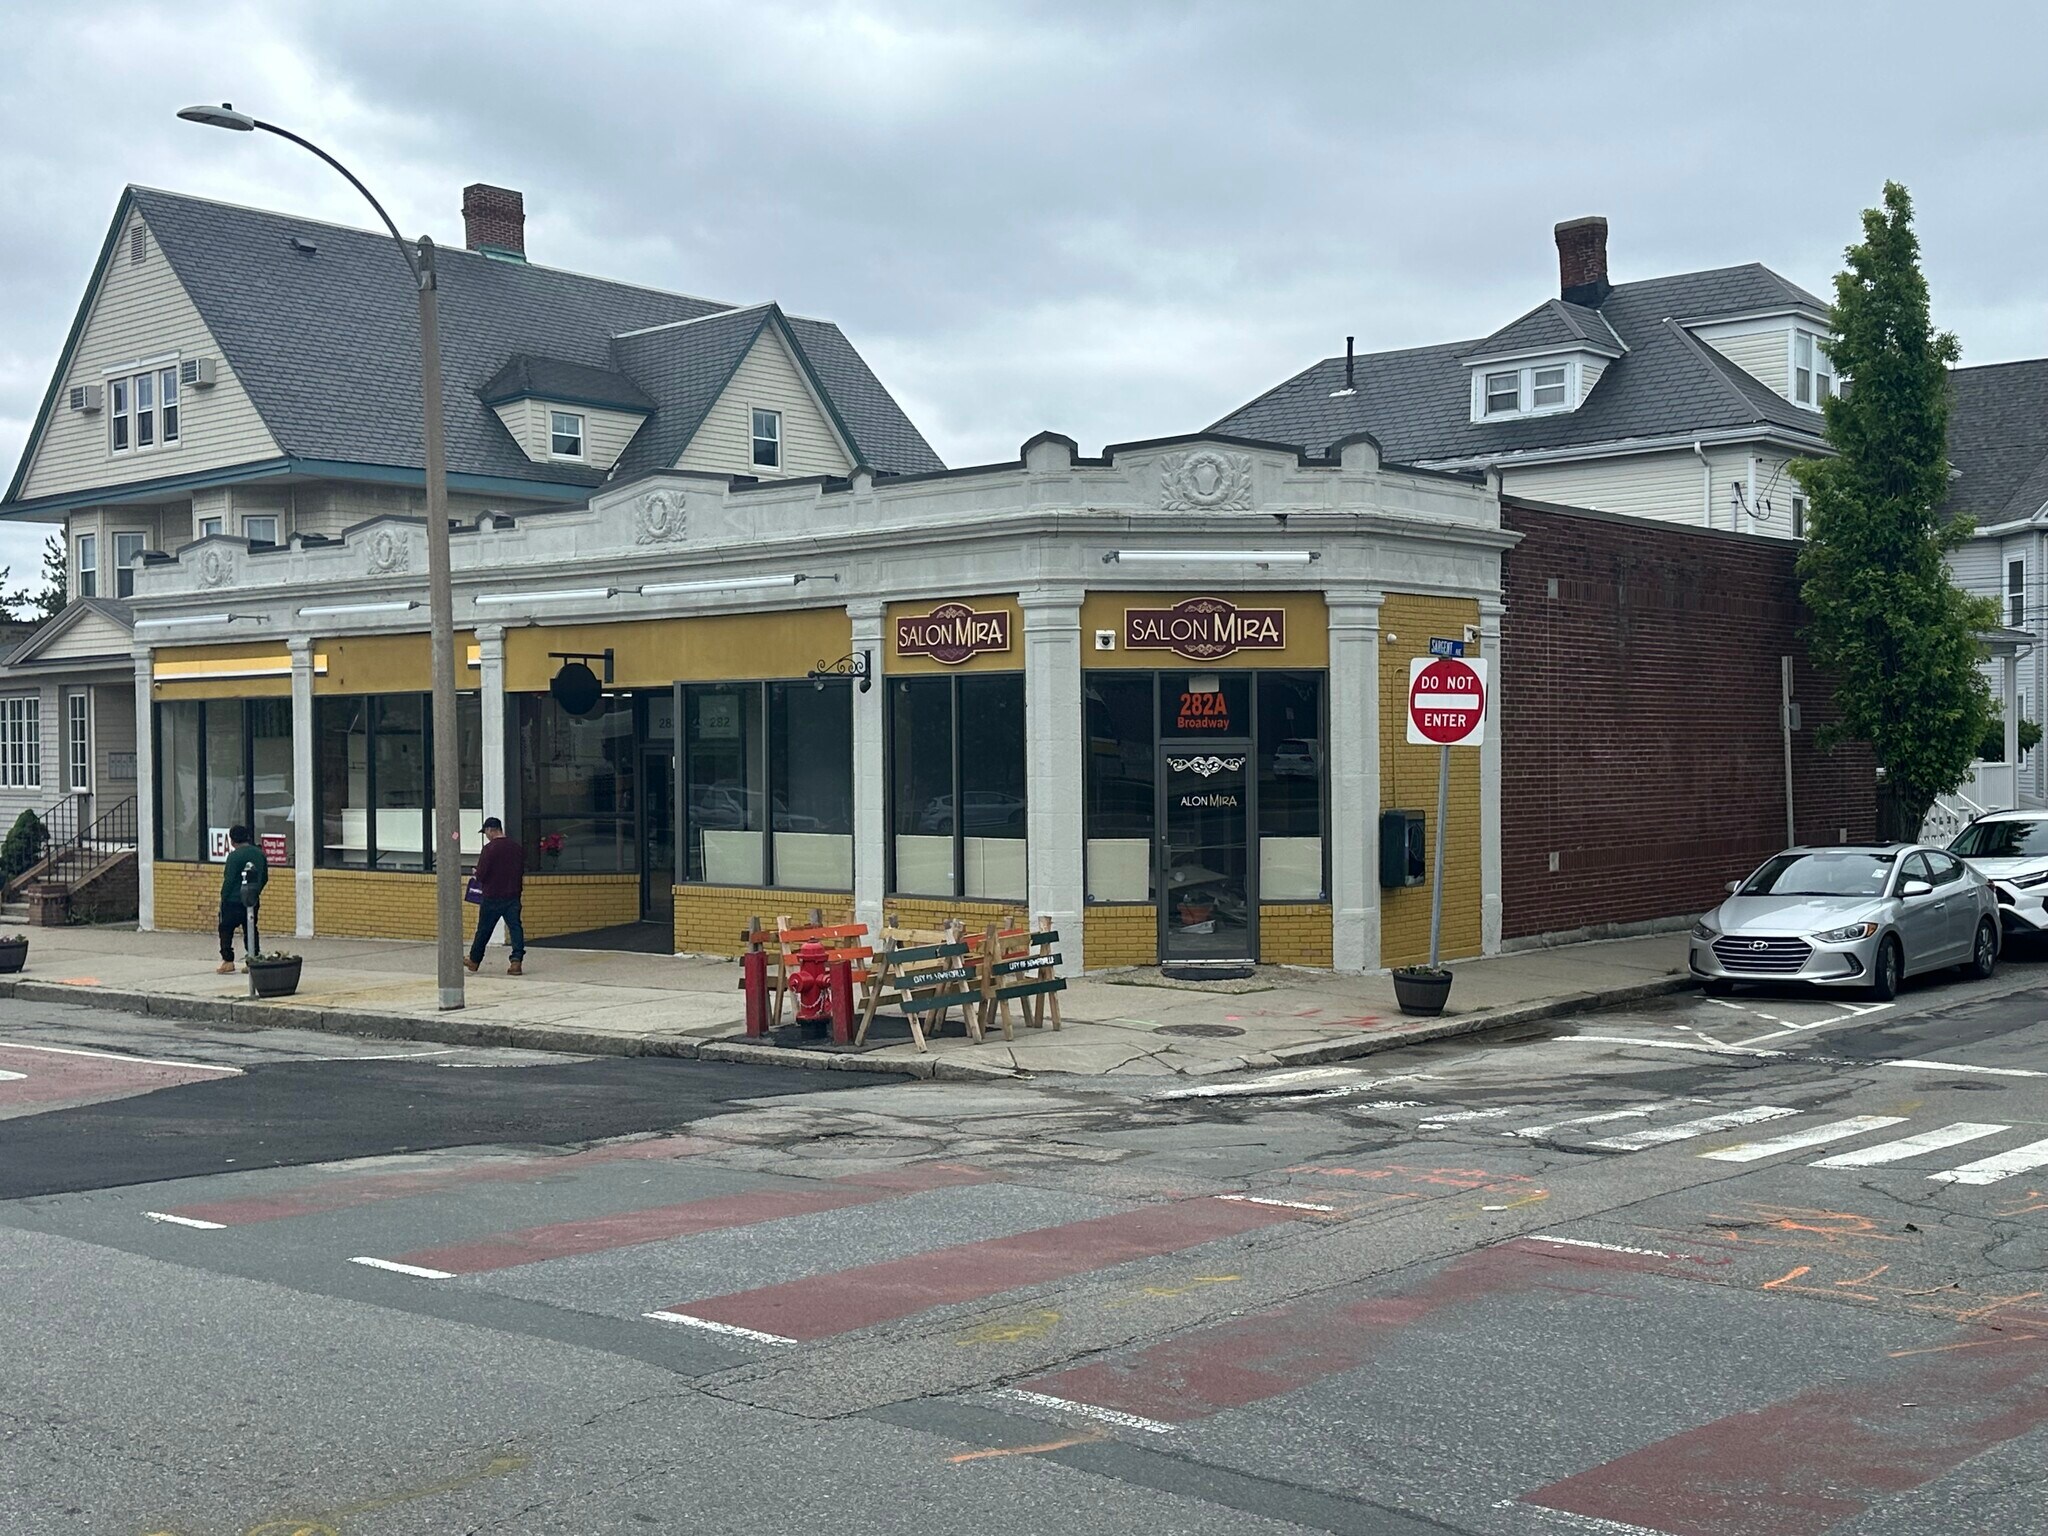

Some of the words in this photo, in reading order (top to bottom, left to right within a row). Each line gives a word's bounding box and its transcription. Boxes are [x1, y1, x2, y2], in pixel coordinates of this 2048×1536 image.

[899, 624, 952, 647] SALON
[956, 617, 1003, 647] MIRA
[1131, 619, 1208, 640] SALON
[1214, 613, 1279, 644] MIRA
[1431, 639, 1453, 655] SARGENT
[1421, 676, 1439, 689] DO
[1447, 676, 1473, 689] NOT
[1180, 693, 1227, 716] 282A
[659, 718, 674, 728] 28
[710, 717, 730, 728] 282
[1177, 716, 1229, 731] Broadway
[1424, 713, 1466, 727] ENTER
[1180, 795, 1208, 806] ALON
[1209, 793, 1237, 807] MIRA
[211, 832, 232, 856] LEA
